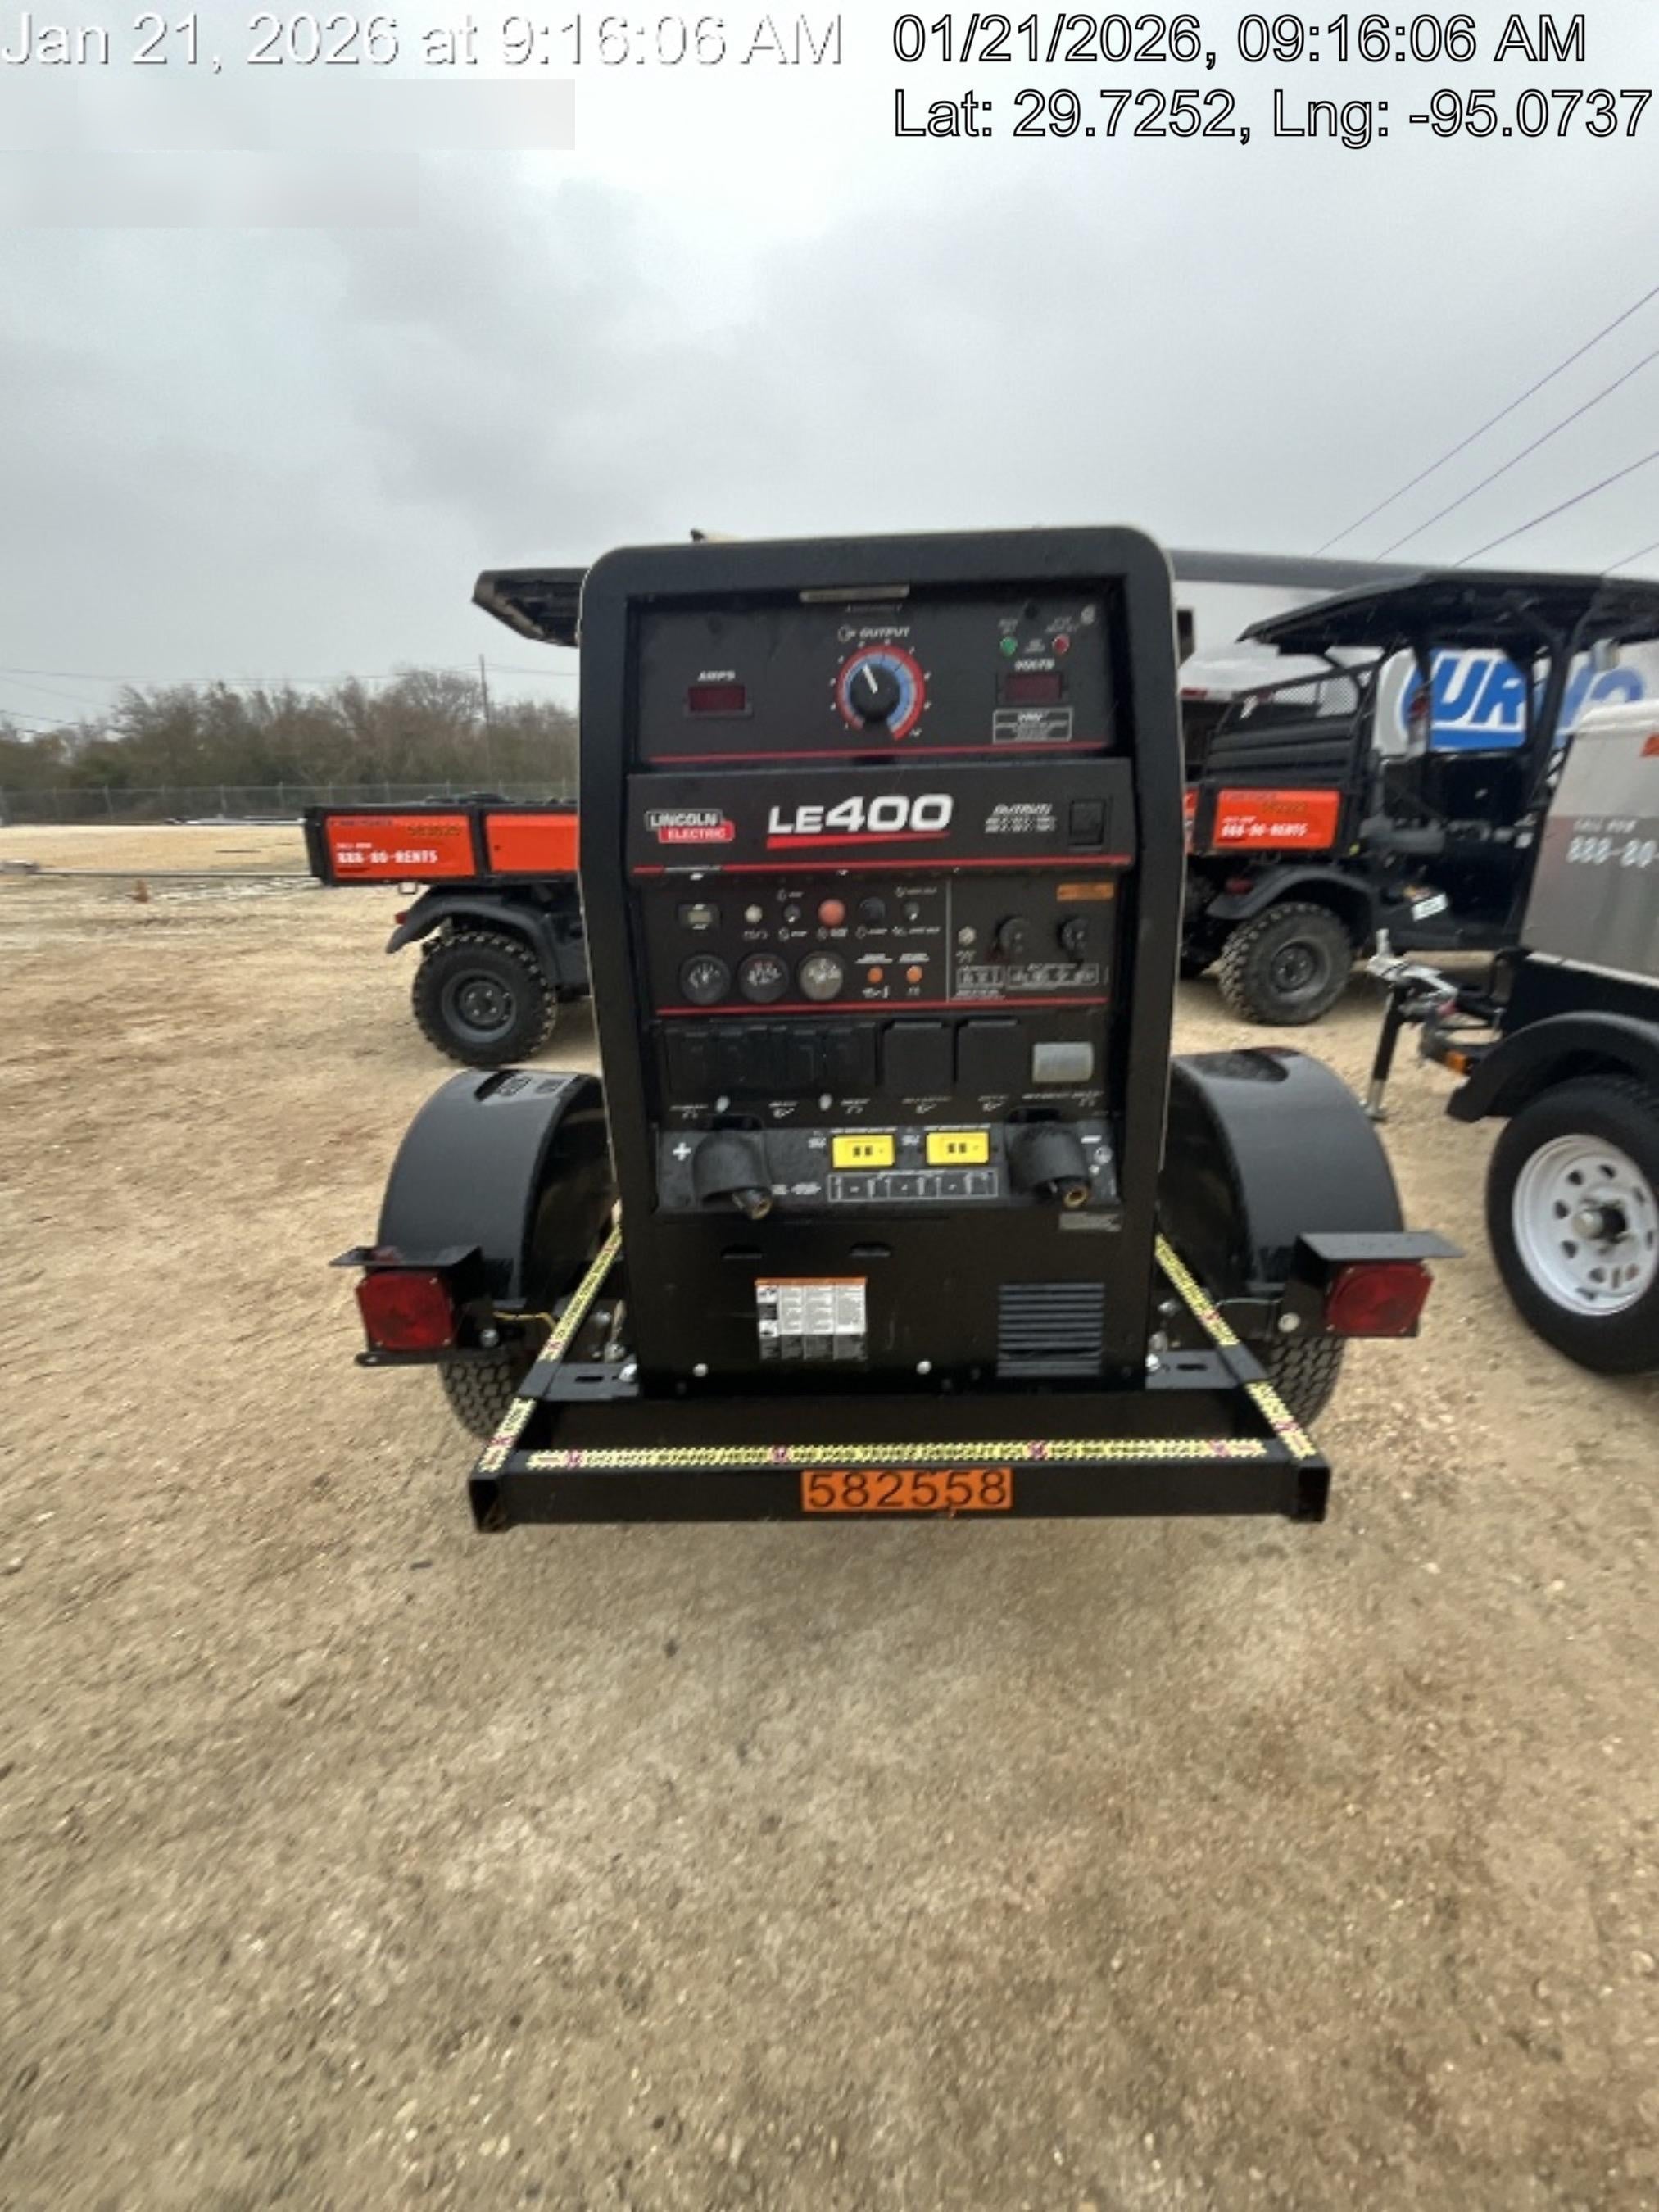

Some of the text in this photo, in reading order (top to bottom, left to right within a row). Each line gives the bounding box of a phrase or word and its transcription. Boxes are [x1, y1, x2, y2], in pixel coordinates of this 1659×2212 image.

[859, 626, 911, 637] OUTPUT
[650, 811, 718, 827] LINCOLN
[768, 793, 954, 834] LE400
[667, 827, 727, 840] ELECTRIC
[809, 1471, 1007, 1508] 582558
